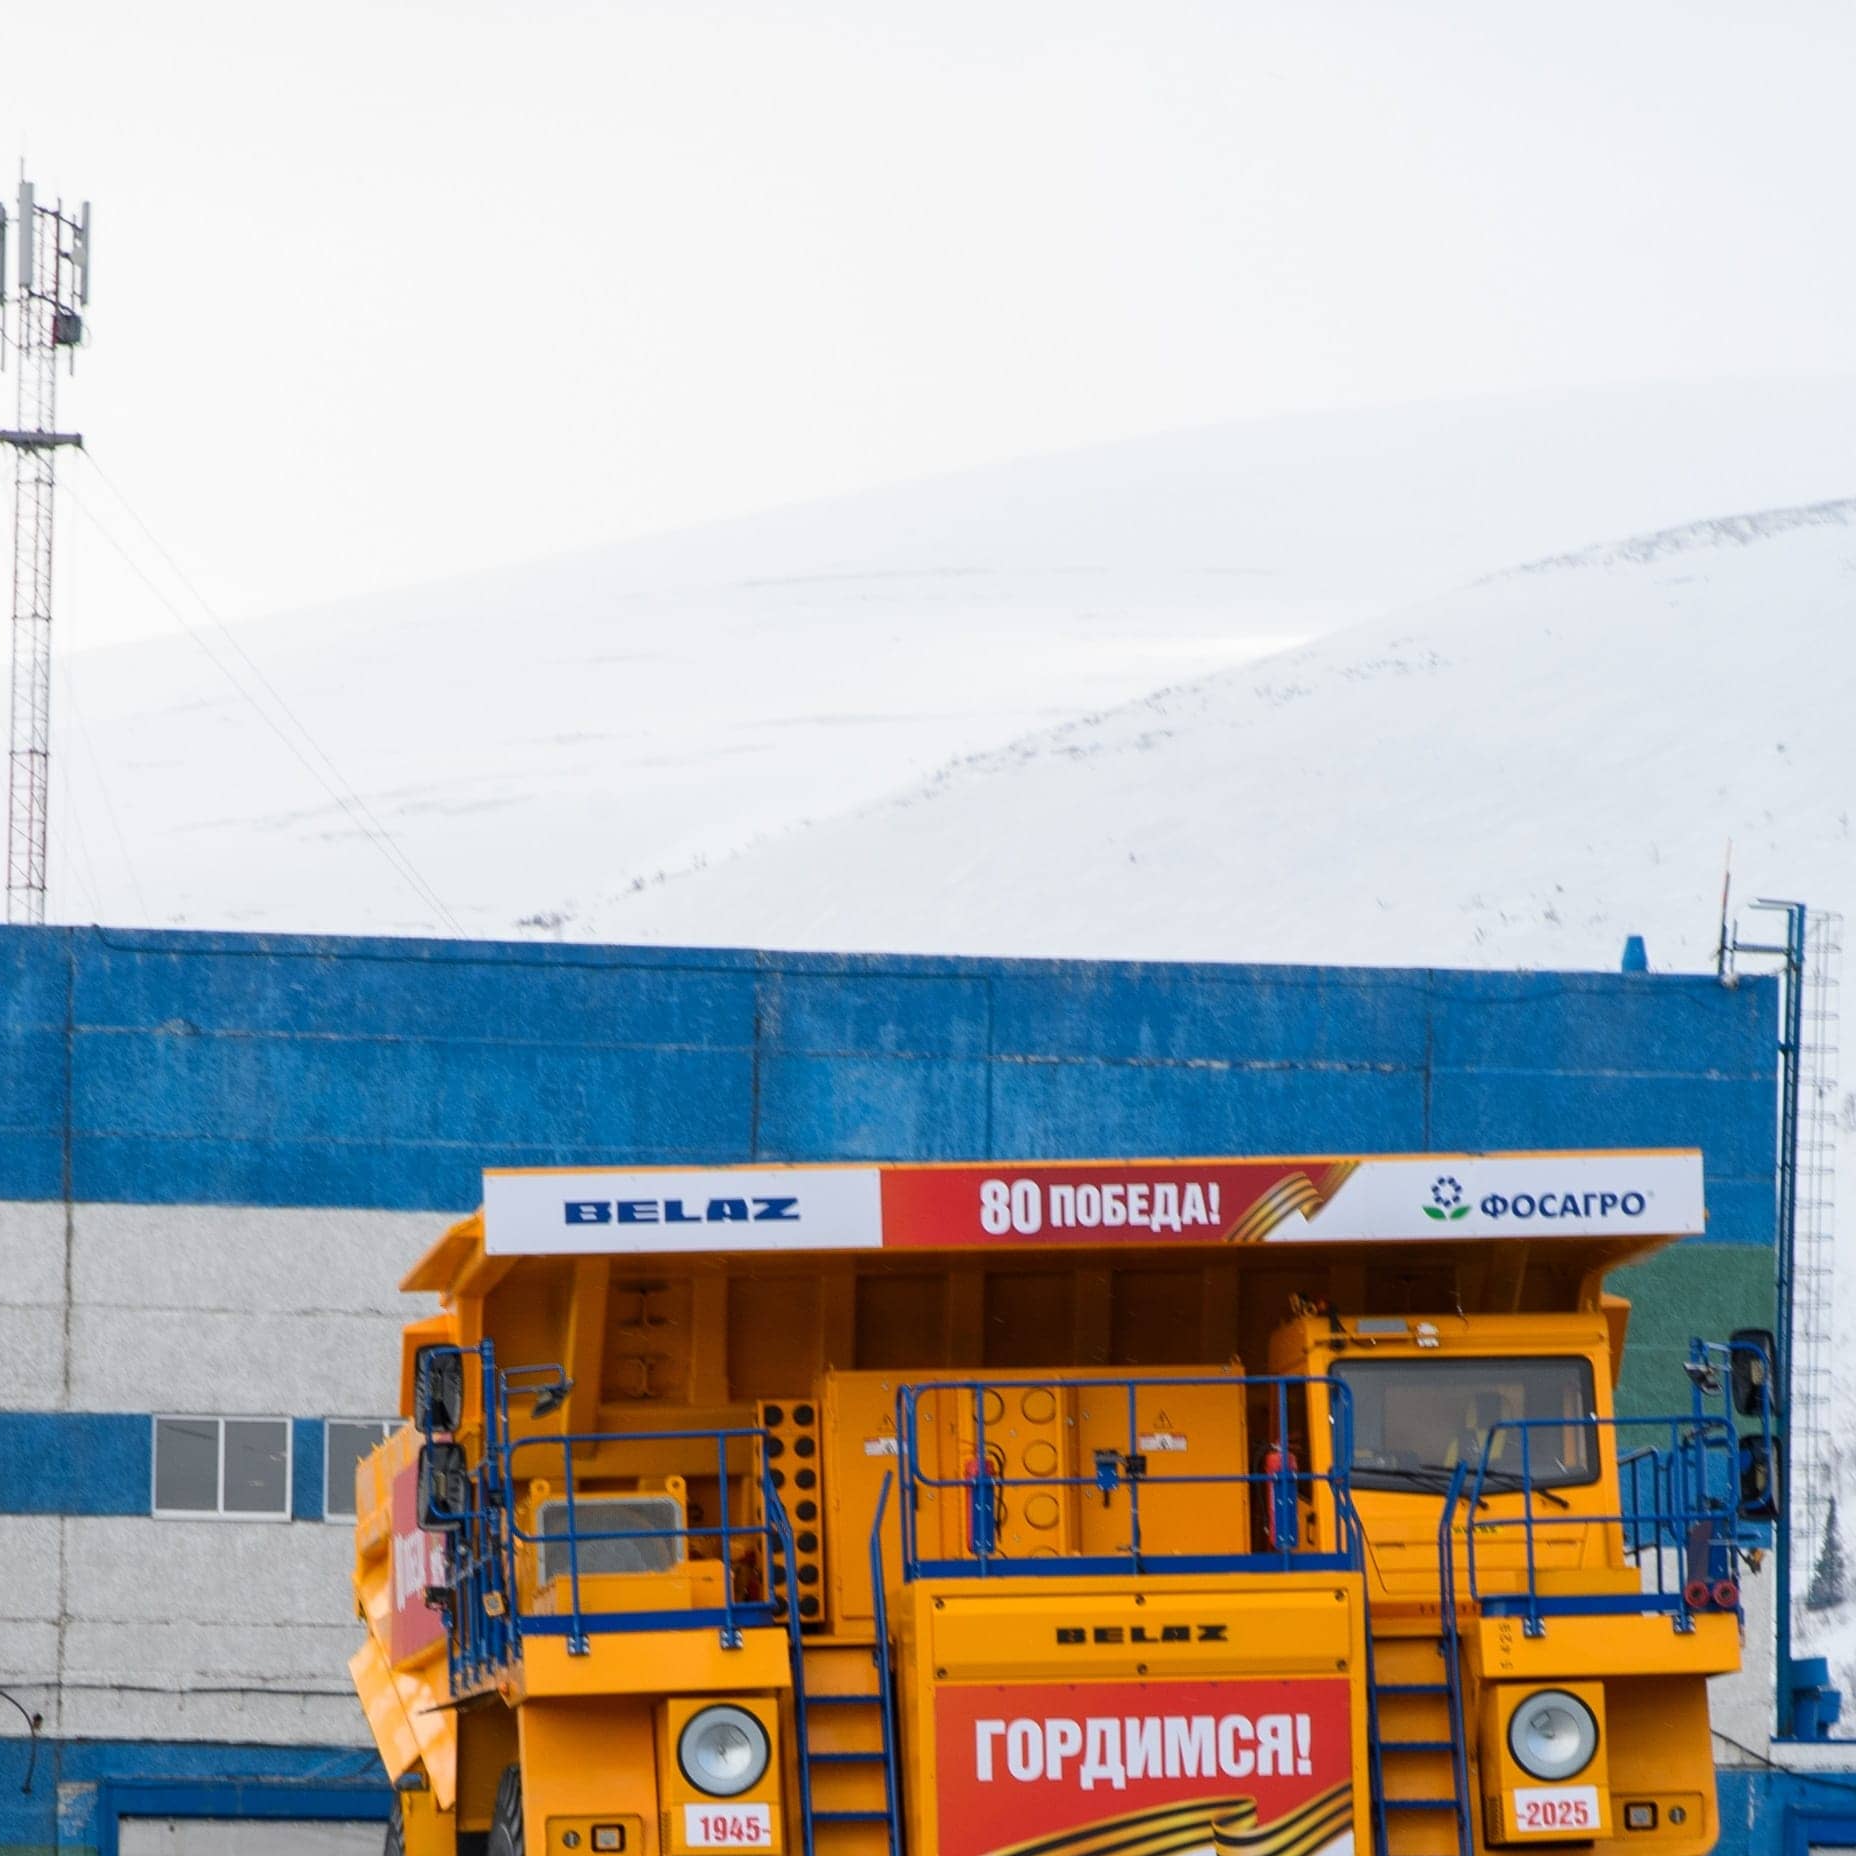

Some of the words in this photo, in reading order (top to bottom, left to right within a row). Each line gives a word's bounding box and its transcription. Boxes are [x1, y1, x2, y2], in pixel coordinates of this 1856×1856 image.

[564, 1197, 800, 1225] BELAZ
[980, 1178, 1042, 1235] 80
[1048, 1181, 1221, 1232] ПОБЕДА!
[1481, 1190, 1646, 1219] ФОСАГРО
[1056, 1624, 1228, 1644] BELAZ
[975, 1713, 1312, 1790] ГОРДИМСЯ!
